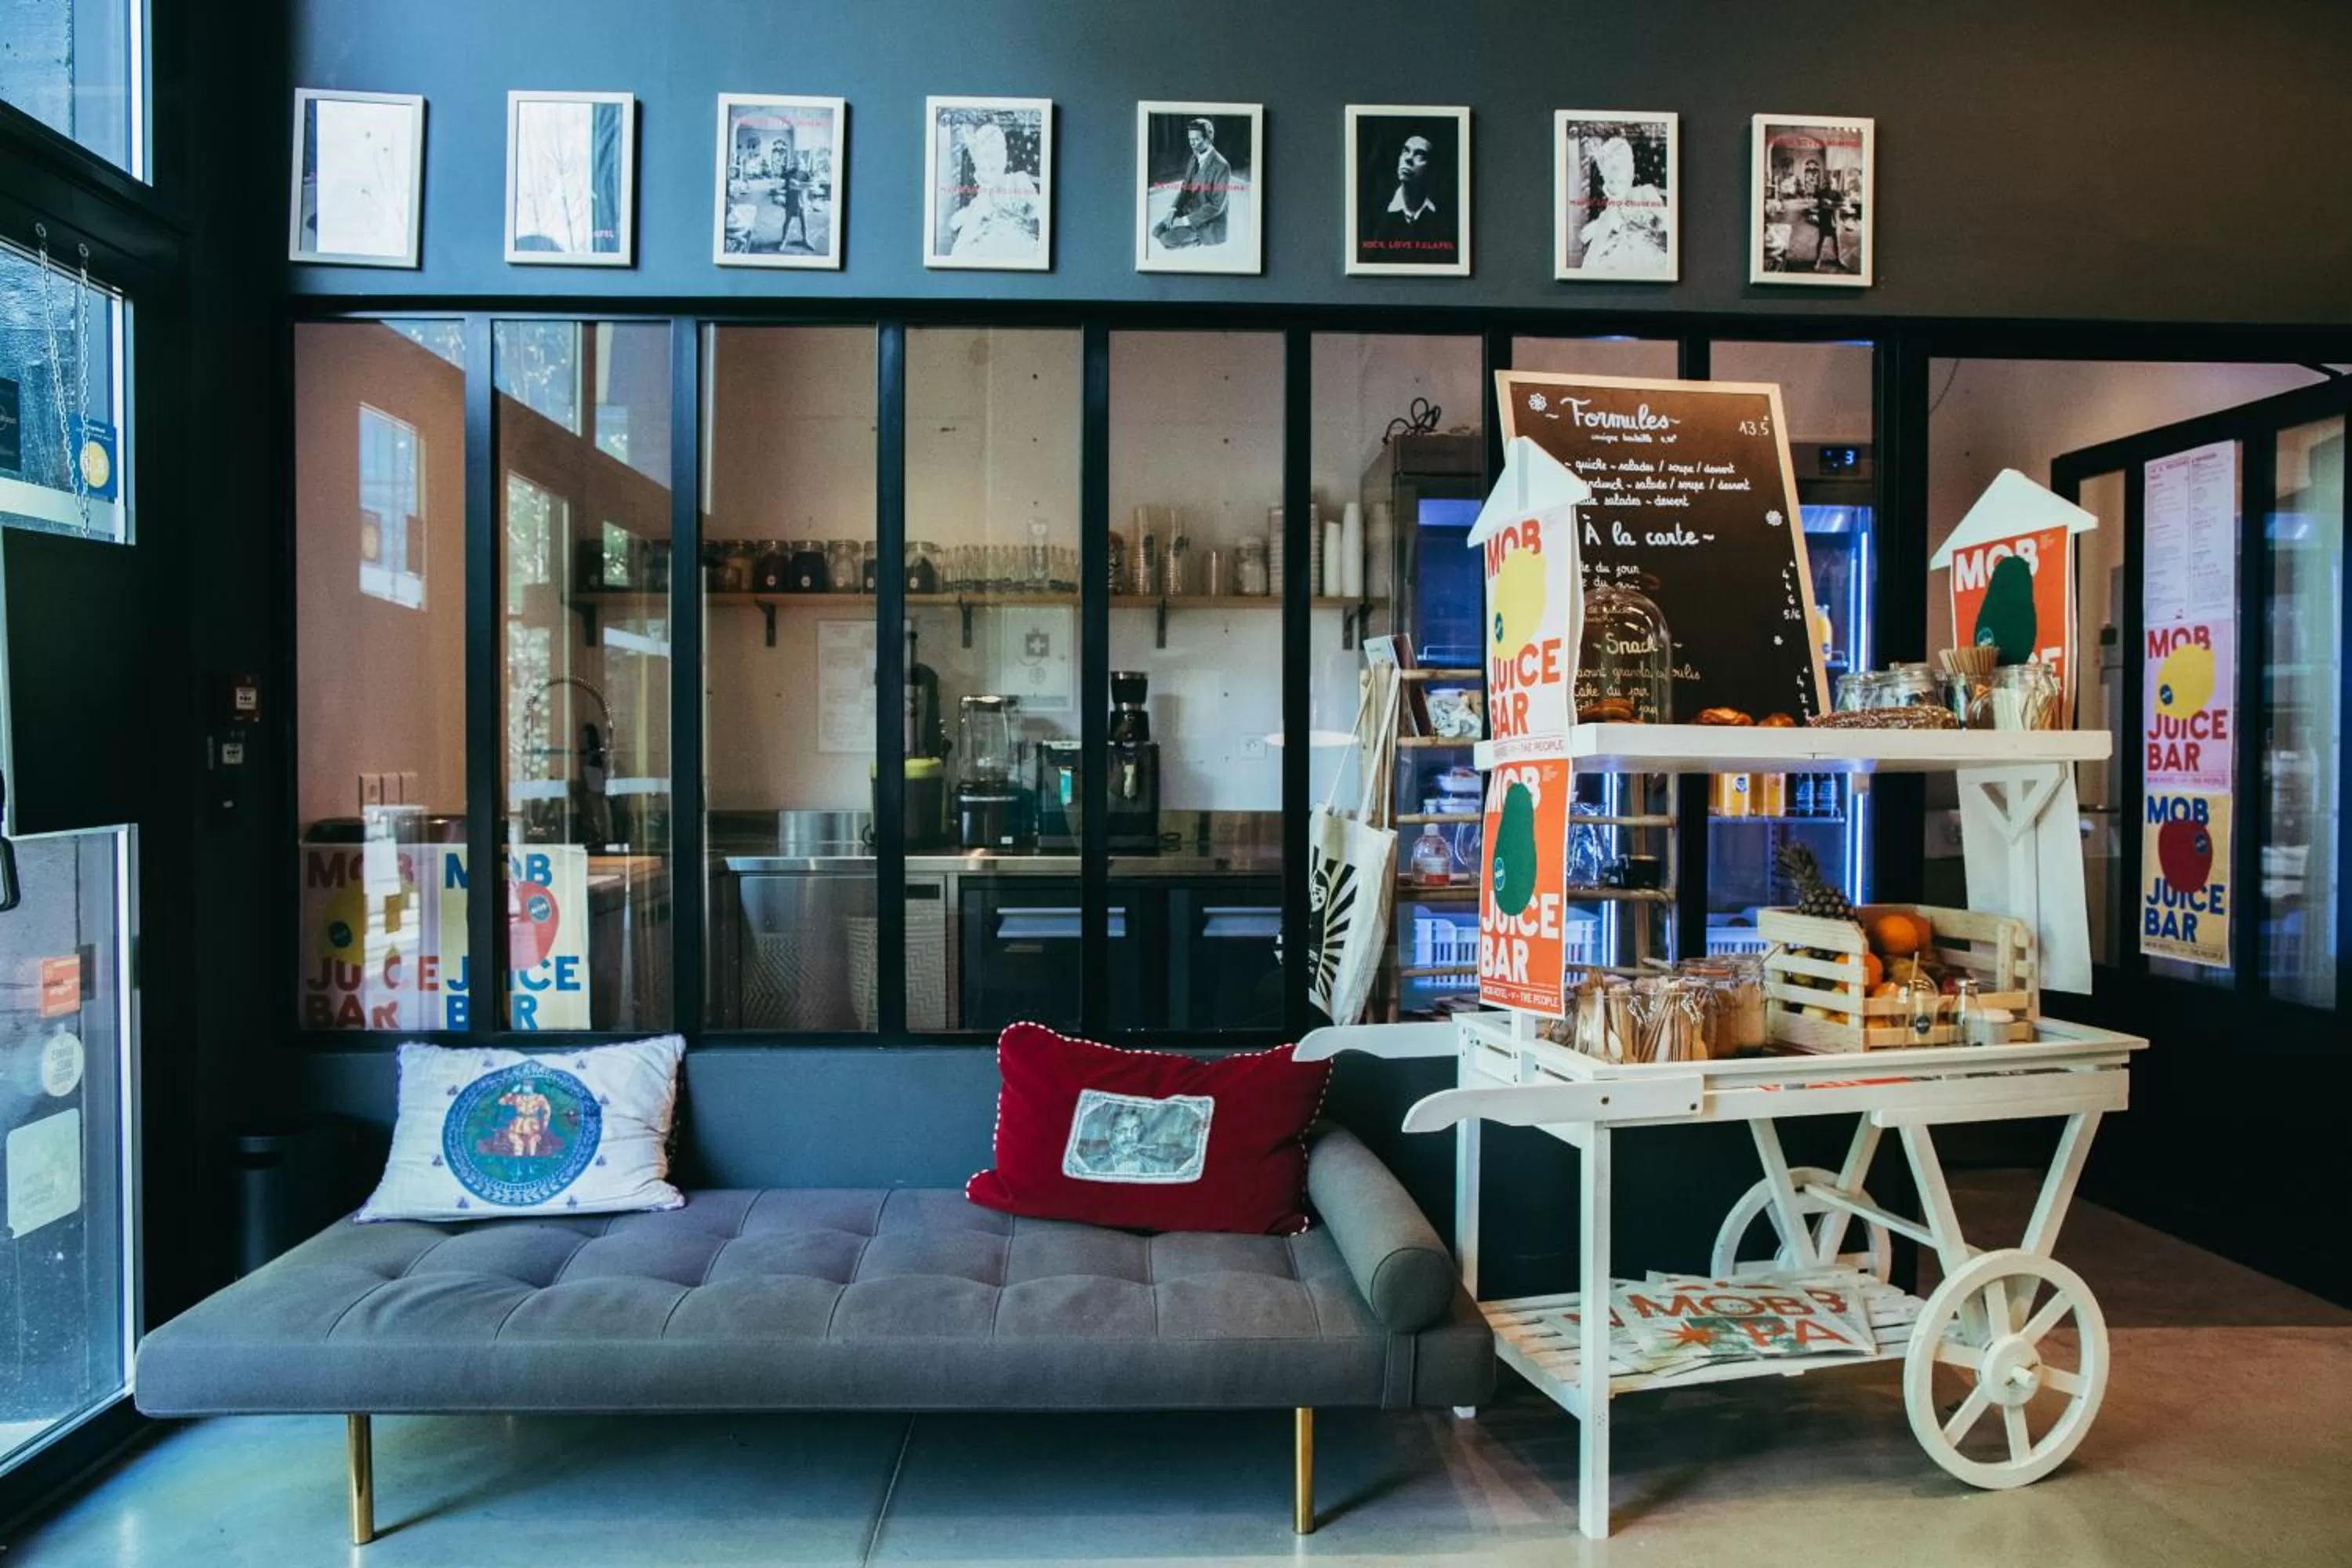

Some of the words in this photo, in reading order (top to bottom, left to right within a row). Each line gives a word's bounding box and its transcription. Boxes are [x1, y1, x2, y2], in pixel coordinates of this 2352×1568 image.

[1560, 397, 1669, 430] Formules
[1604, 492, 1642, 506] salades
[1582, 514, 1602, 546] À
[1612, 521, 1637, 546] la
[1645, 521, 1700, 546] carte
[1487, 518, 1542, 580] MOB
[1956, 539, 2039, 592] MOB
[1606, 632, 1658, 655] Snack
[2148, 626, 2211, 659] MOB
[1491, 637, 1562, 695] JUICE
[1491, 691, 1529, 741] BAR
[2147, 709, 2227, 740] JUICE
[2147, 742, 2201, 772] BAR
[1486, 766, 1541, 813] MOB
[2147, 795, 2209, 826] MOB
[2147, 877, 2225, 916] JUICE
[1482, 891, 1560, 939] JUICE
[2145, 907, 2198, 943] BAR
[307, 956, 439, 992] JUCE
[1481, 935, 1529, 984] BAR
[446, 994, 539, 1029] BR
